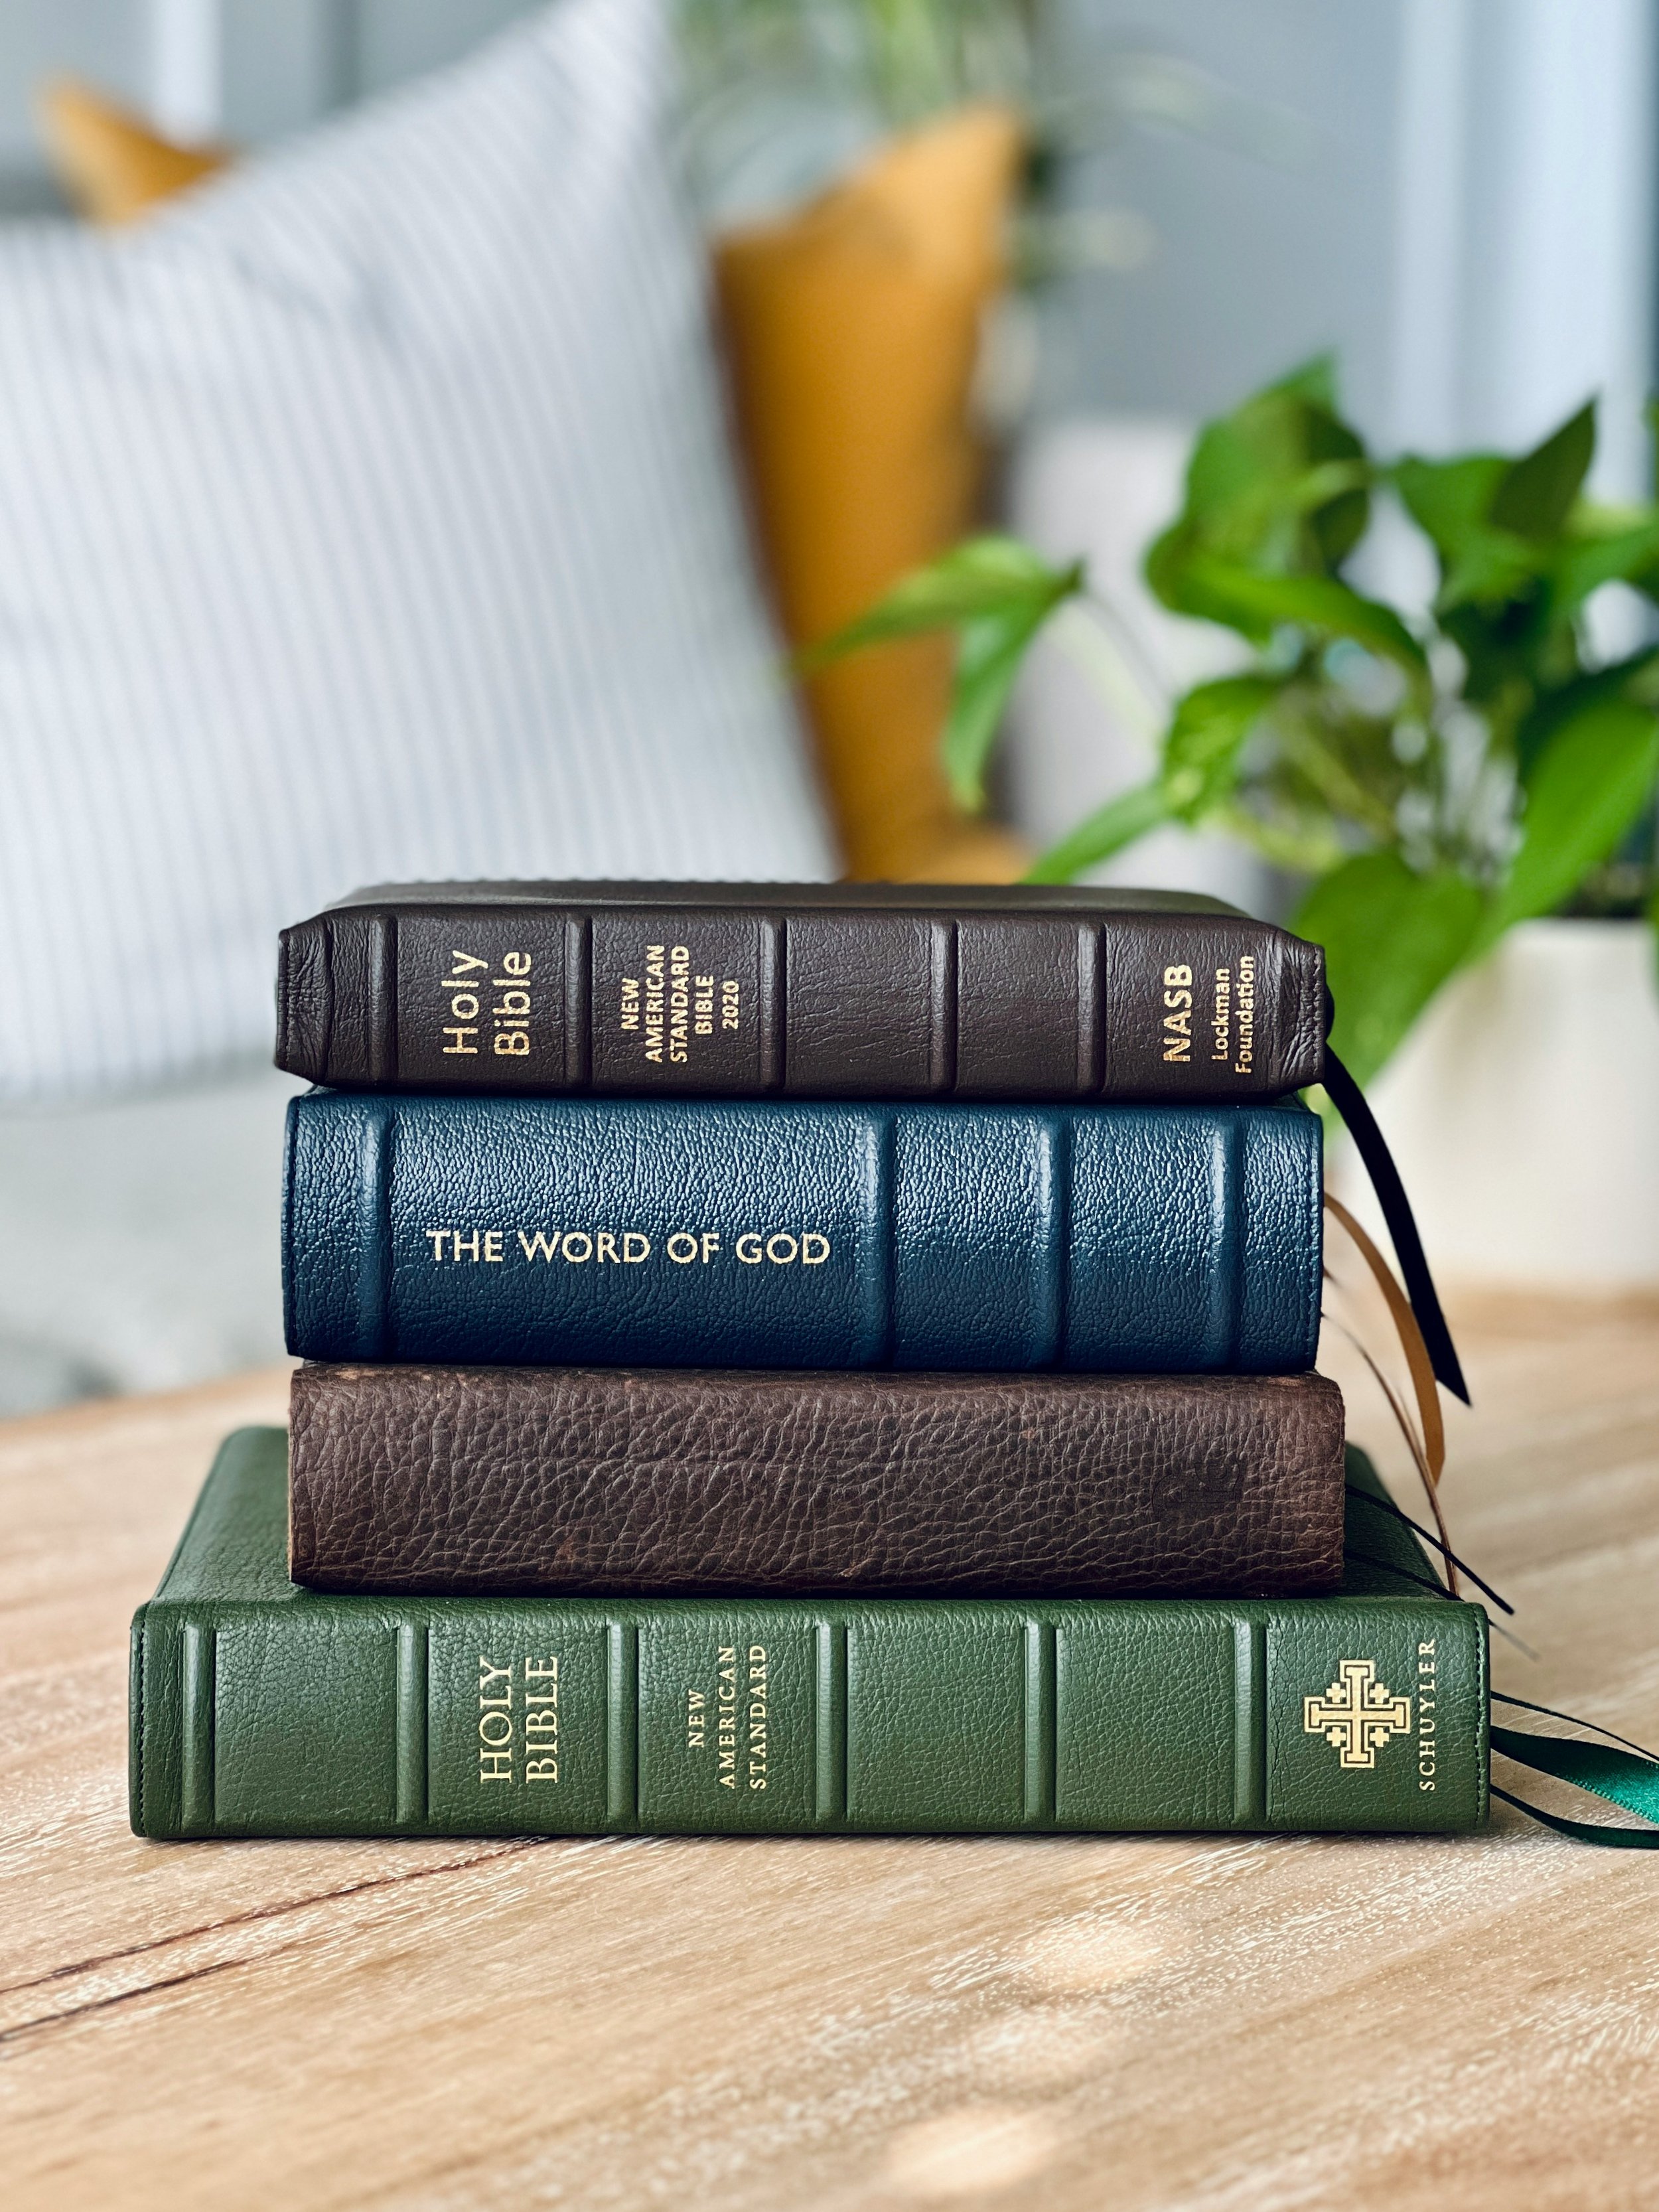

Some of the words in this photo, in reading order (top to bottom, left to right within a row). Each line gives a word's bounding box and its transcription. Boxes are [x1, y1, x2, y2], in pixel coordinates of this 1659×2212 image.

[441, 950, 488, 1054] Holy
[493, 952, 532, 1055] Bible
[621, 978, 639, 1030] NEW
[646, 945, 665, 1063] AMERICAN
[670, 946, 689, 1063] STANDARD
[695, 975, 713, 1035] BIBLE
[722, 980, 739, 1029] 2020
[1163, 964, 1192, 1062] NASB
[1211, 968, 1230, 1061] Lockman
[1235, 955, 1255, 1073] Foundation
[426, 1228, 503, 1262] THE
[518, 1230, 651, 1264] WORD
[667, 1232, 719, 1264] OF
[735, 1231, 830, 1264] GOD
[479, 1656, 513, 1783] HOLY
[526, 1656, 558, 1784] BIBLE
[688, 1689, 705, 1748] NEW
[719, 1645, 737, 1789] AMERICAN
[749, 1645, 768, 1790] STANDARD
[1418, 1639, 1436, 1791] SCHUYLER
